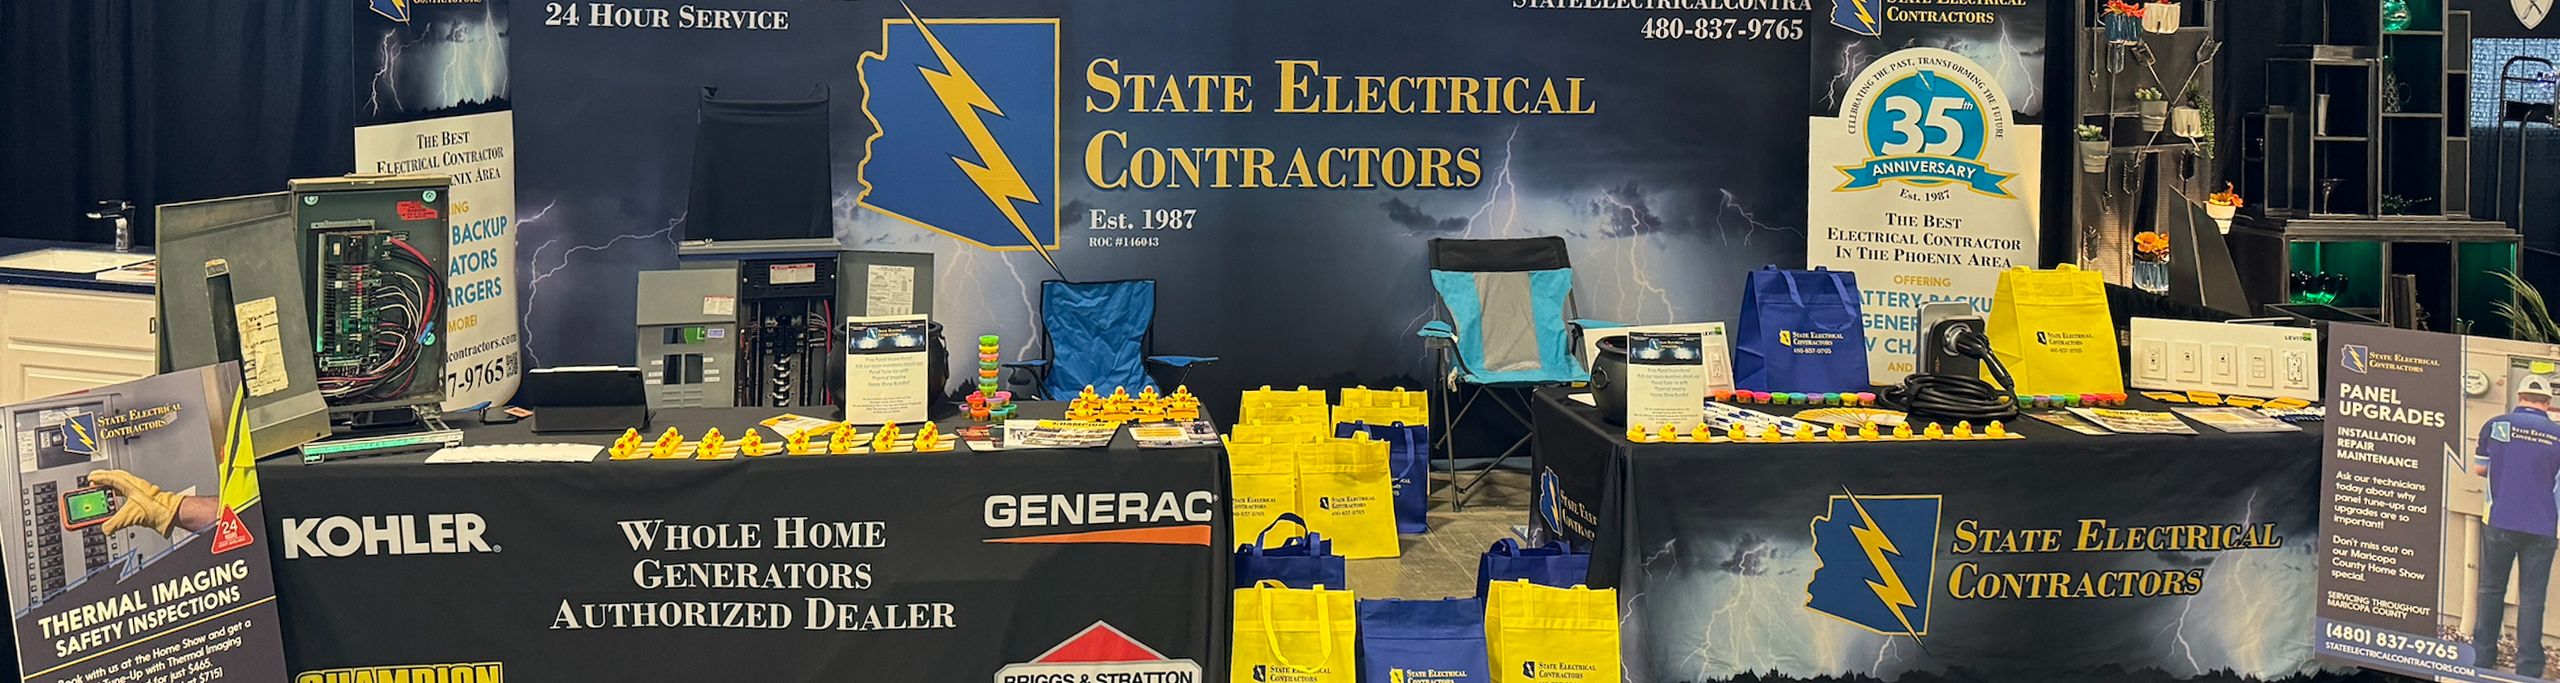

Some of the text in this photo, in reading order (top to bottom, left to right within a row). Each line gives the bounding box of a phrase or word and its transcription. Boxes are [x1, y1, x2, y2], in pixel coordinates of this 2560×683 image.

[545, 2, 789, 30] 24 HOUR SERVICE
[1887, 6, 1995, 24] CONTRACTORS
[1641, 17, 1804, 40] 480-837-9765
[1085, 57, 1597, 115] STATE ELECTRICAL
[1848, 57, 2004, 139] CELEBRATING THE PAST, TRANSFORMING THE FUTURE
[416, 131, 471, 150] THE BEST
[377, 146, 504, 174] ELECTRICAL CONTRACTOR
[1085, 130, 1482, 190] CONTRACTORS
[1872, 160, 1977, 179] ANNIVERSARY
[450, 167, 501, 186] NIX AREA
[1900, 188, 1951, 202] Est. 1987
[1089, 208, 1197, 230] Est. 1987
[1885, 212, 1962, 229] THE BEST
[452, 215, 508, 246] BACKUP
[1827, 227, 2021, 250] ELECTRICAL CONTRACTOR
[1089, 237, 1159, 247] ROC #146043
[1835, 245, 2012, 268] IN THE PHOENIX AREA
[1893, 275, 1951, 287] OFFERING
[448, 314, 478, 333] MORE!
[1887, 362, 1913, 373] AND
[2369, 351, 2440, 367] STATE ELECTRICAL
[2369, 360, 2424, 373] CONTRACTORS
[448, 357, 504, 397] 7-9765
[2340, 383, 2401, 405] PANEL
[97, 402, 183, 428] STATE ELECTRICAL
[2338, 400, 2446, 428] UPGRADES
[100, 419, 167, 440] CONTRACTORS
[2337, 426, 2416, 446] INSTALLATION
[2337, 438, 2374, 451] REPAIR
[2336, 449, 2419, 469] MAINTENANCE
[2335, 470, 2426, 492] Ask our technicians
[2335, 482, 2416, 502] today about why
[984, 490, 1213, 528] GENERAC
[2334, 493, 2427, 514] panel tune-ups and
[2334, 504, 2410, 522] upgrades are so
[222, 519, 238, 534] 24
[2333, 514, 2384, 529] important!
[617, 516, 887, 552] WHOLE HOME
[1953, 518, 2283, 554] STATE ELECTRICAL
[2332, 535, 2414, 557] Don't miss out on
[2332, 548, 2396, 565] our Maricopa
[632, 558, 873, 591] GENERATORS
[2331, 569, 2366, 582] special.
[2332, 557, 2425, 581] County Home Show
[1948, 562, 2204, 600] CONTRACTORS
[38, 559, 249, 640] THERMAL IMAGING
[2327, 590, 2430, 616] SERVICING THROUGHOUT
[2327, 598, 2408, 620] MARICOPA COUNTY
[55, 585, 241, 658] SAFETY INSPECTIONS
[549, 597, 957, 632] AUTHORIZED DEALER
[85, 620, 252, 681] with us at the Home Show and get a
[2326, 622, 2458, 660] (480) 837-9765
[145, 661, 166, 676] with
[167, 647, 205, 668] Thermal
[205, 636, 242, 655] Imaging
[2325, 641, 2475, 677] STATEELECTRICALCONTRACTORS.COM
[170, 667, 187, 683] just
[188, 658, 213, 675] $465.
[1270, 673, 1318, 682] CONTRACTORS
